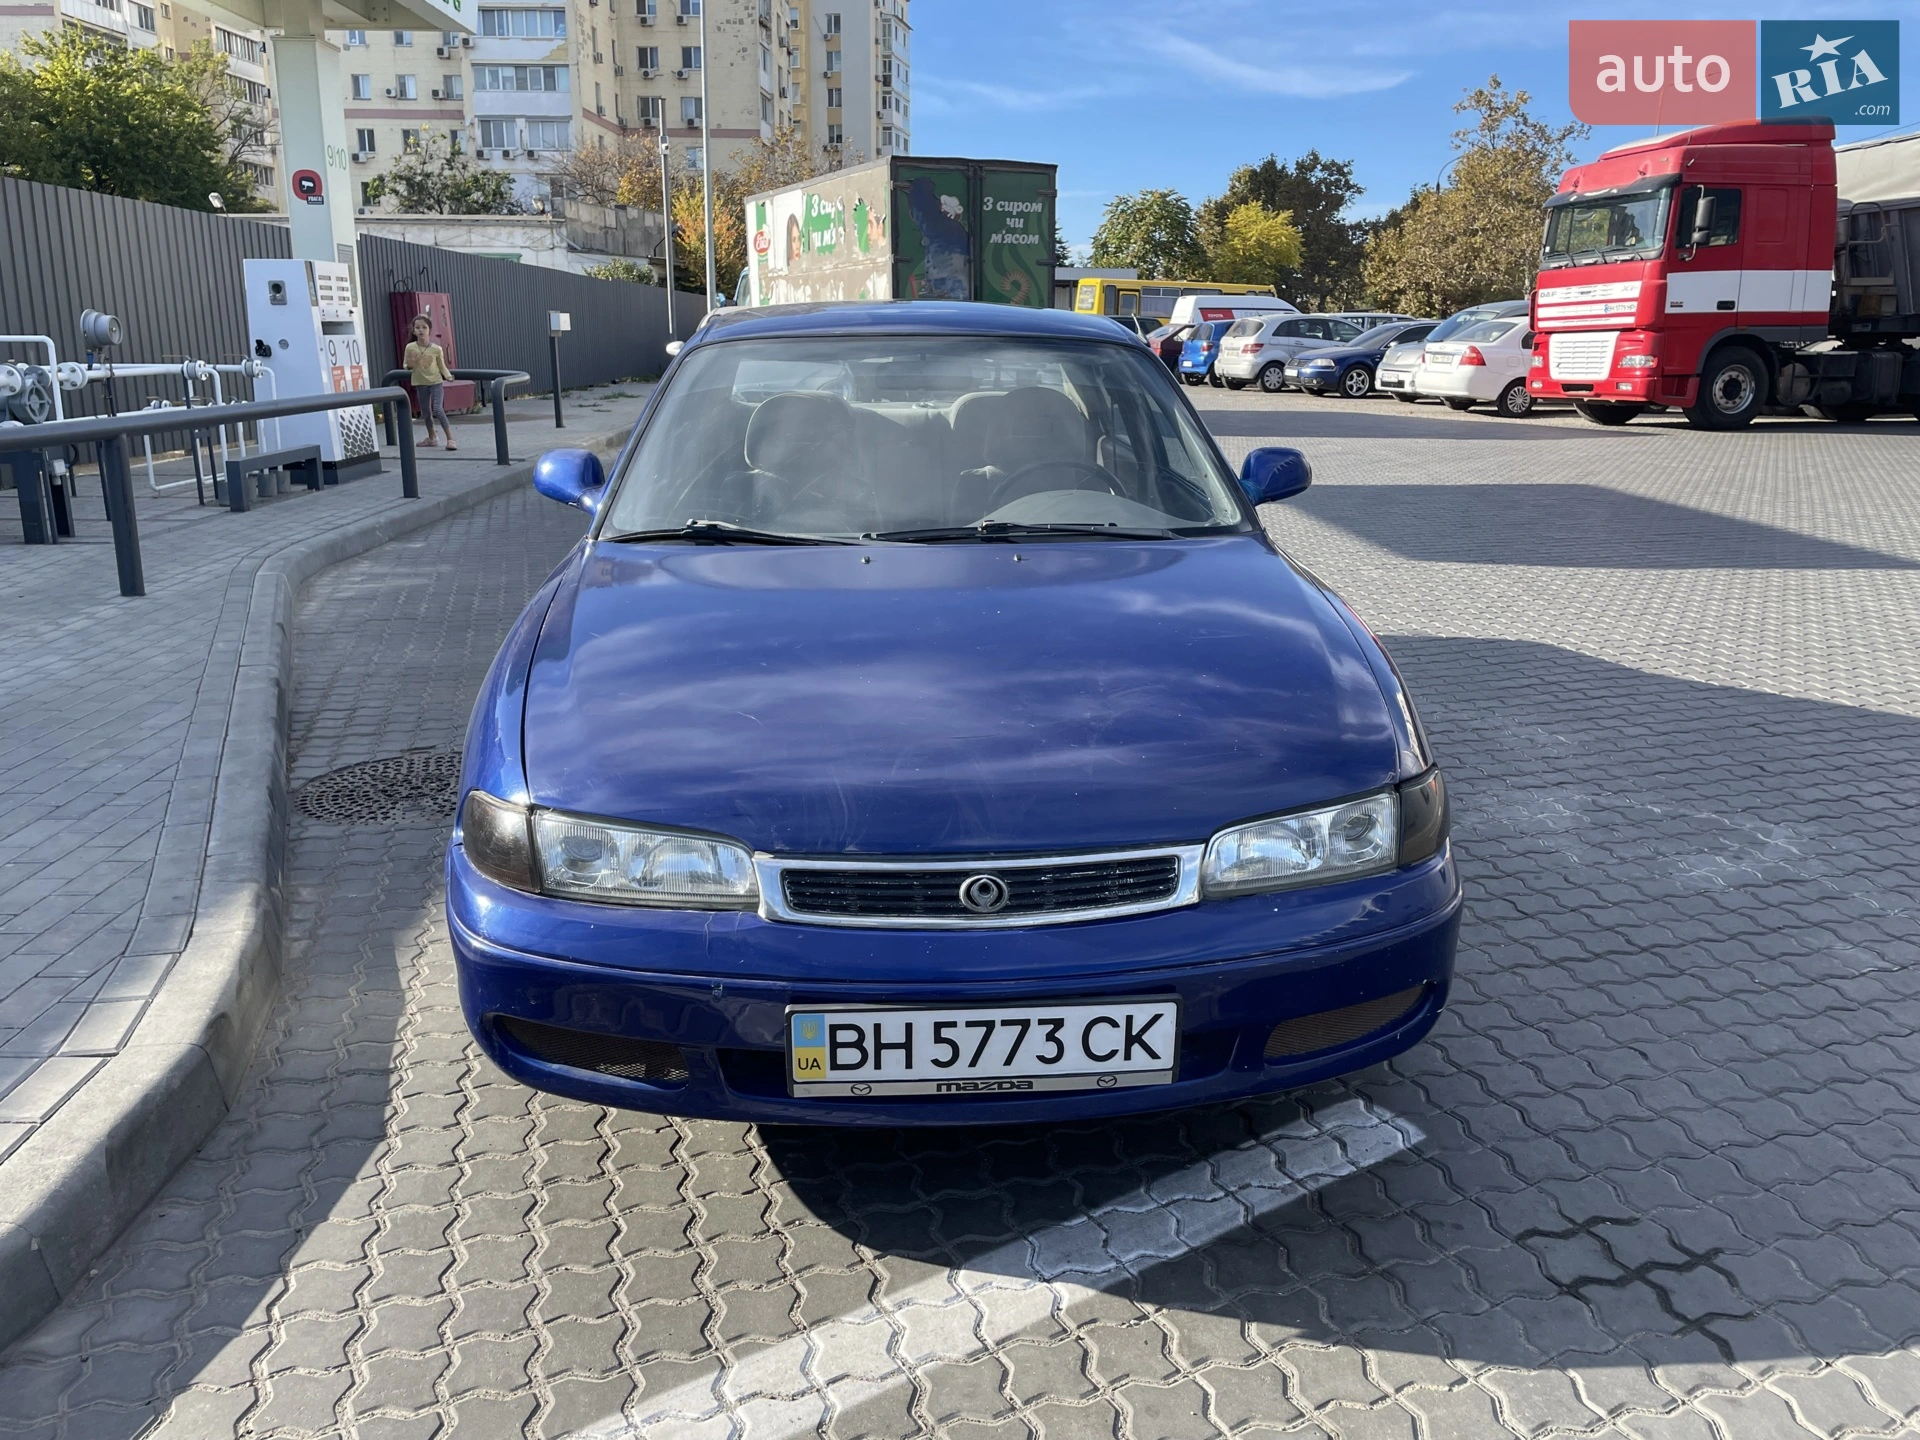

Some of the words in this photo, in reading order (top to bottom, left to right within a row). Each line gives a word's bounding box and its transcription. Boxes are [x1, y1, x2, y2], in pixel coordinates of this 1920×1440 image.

[996, 201, 1042, 215] сиром
[1006, 217, 1024, 228] чи
[989, 230, 1039, 244] м'ясом
[1540, 290, 1557, 298] DAF
[328, 339, 338, 366] 9
[346, 339, 361, 367] 10
[797, 1057, 822, 1071] UA
[828, 1021, 913, 1071] BH
[930, 1017, 1065, 1069] 5773
[1081, 1013, 1164, 1062] CK
